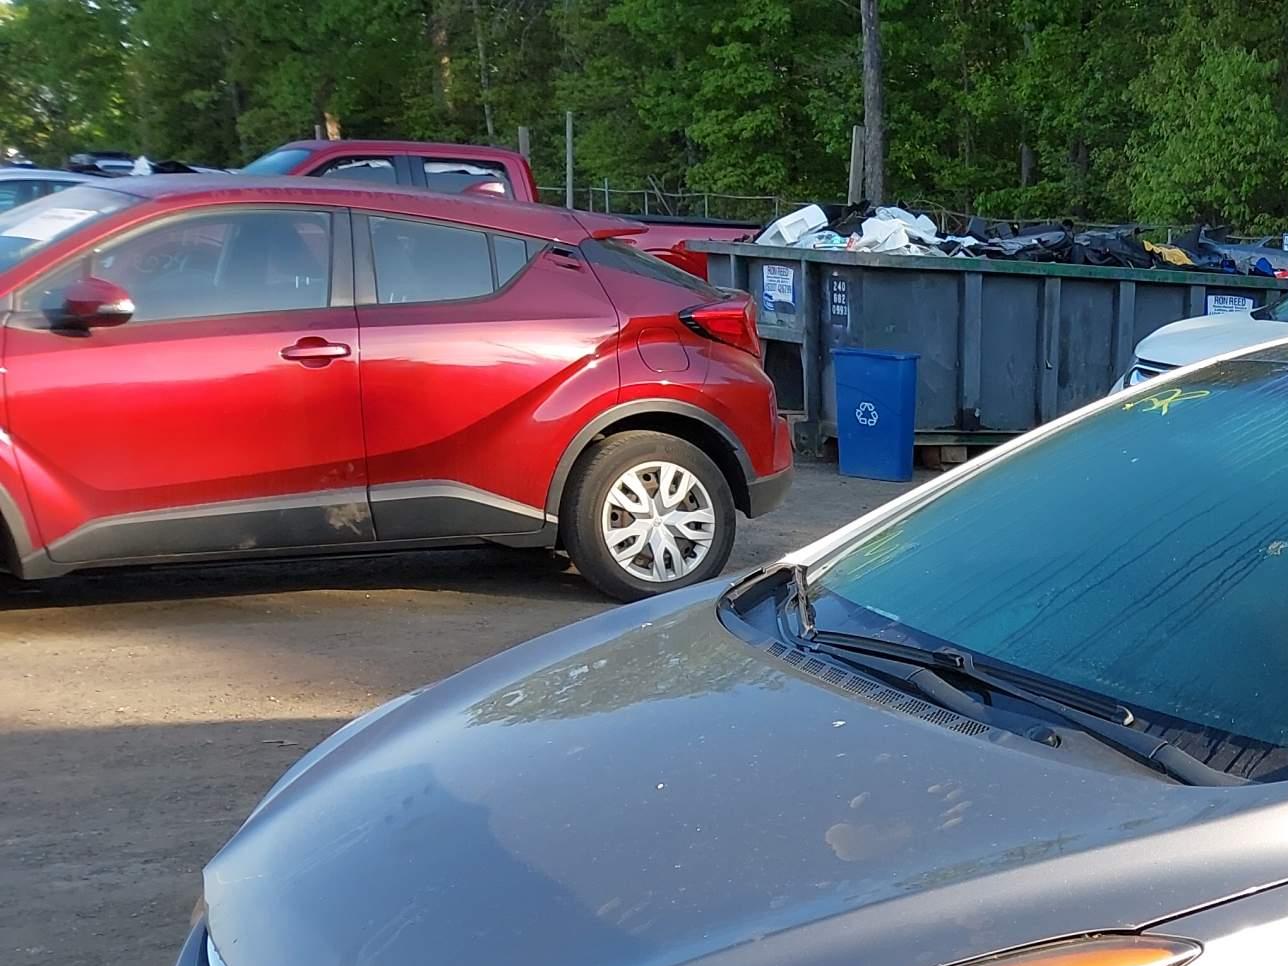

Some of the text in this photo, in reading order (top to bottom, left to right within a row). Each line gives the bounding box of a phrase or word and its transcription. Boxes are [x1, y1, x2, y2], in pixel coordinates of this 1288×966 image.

[833, 281, 846, 292] 240
[1214, 296, 1247, 306] RON REED
